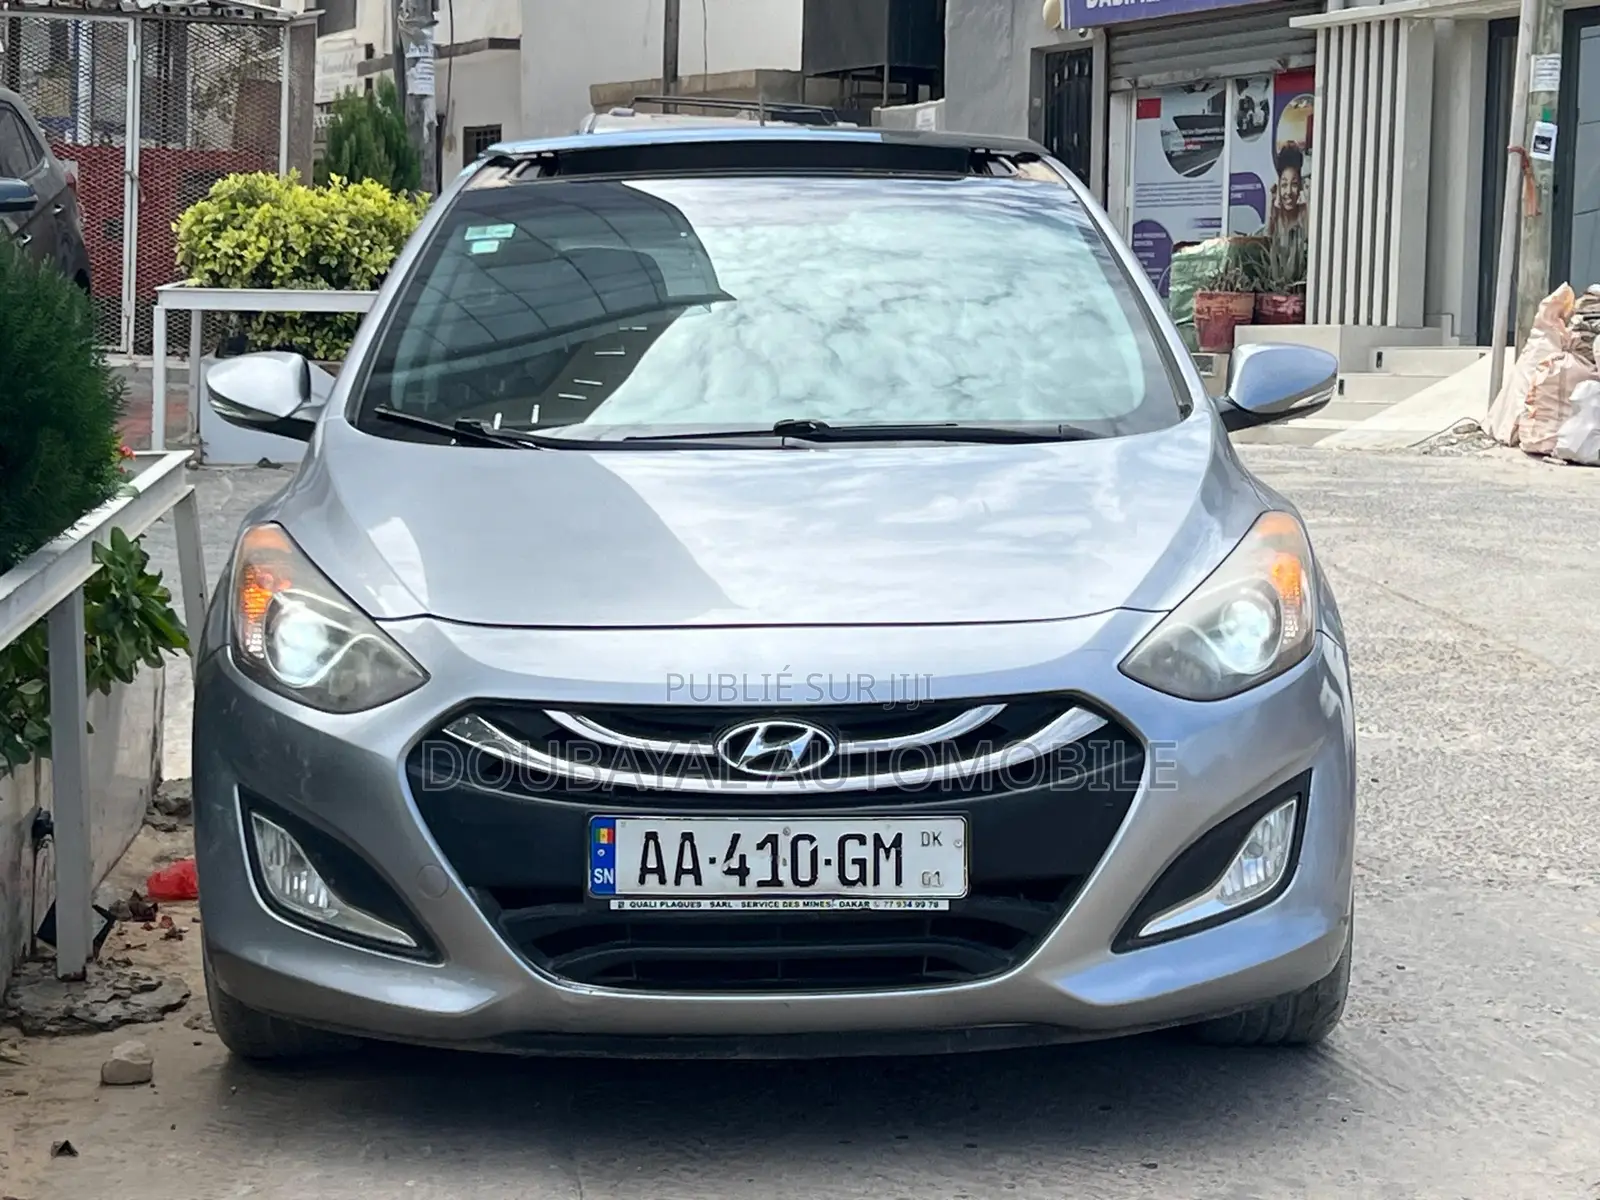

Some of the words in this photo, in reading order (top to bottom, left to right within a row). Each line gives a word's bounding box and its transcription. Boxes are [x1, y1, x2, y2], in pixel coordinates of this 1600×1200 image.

[920, 831, 944, 848] DK
[593, 867, 615, 885] SN
[629, 901, 658, 909] QUALI
[659, 901, 702, 909] PLAQUES
[709, 901, 733, 909] SARL
[740, 901, 780, 909] SERVICE
[782, 901, 801, 909] DES
[802, 901, 832, 909] MINES
[838, 901, 871, 909] DAKAR
